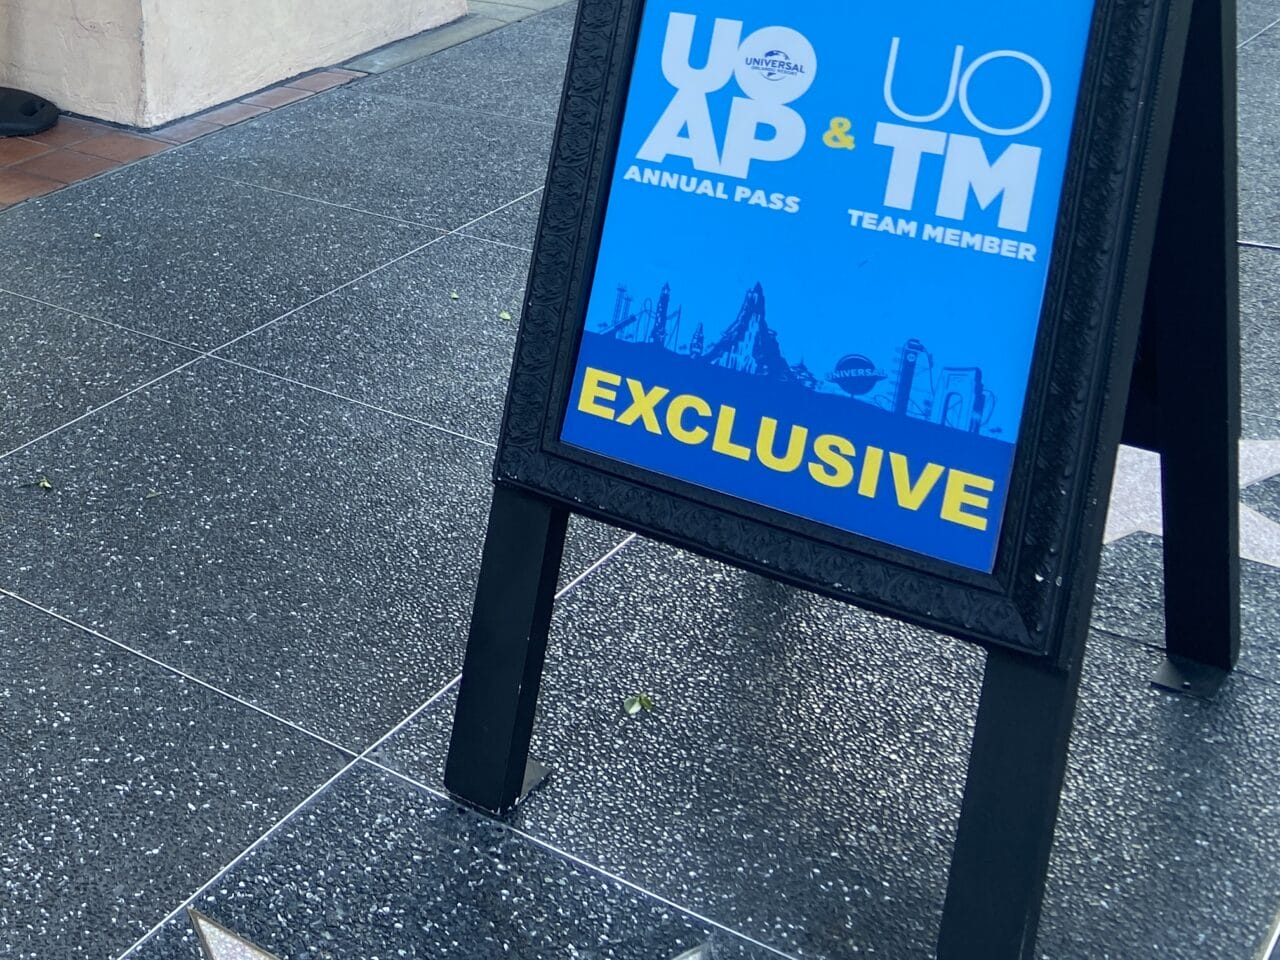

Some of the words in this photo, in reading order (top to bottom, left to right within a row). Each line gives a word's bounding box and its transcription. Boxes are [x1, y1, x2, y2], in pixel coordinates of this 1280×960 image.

[745, 56, 806, 74] UNIVERSAL
[883, 36, 1053, 137] UO
[822, 116, 856, 151] &
[623, 165, 729, 201] ANNUAL
[734, 185, 801, 214] PASS
[873, 121, 1042, 233] TM
[847, 208, 918, 239] TEAM
[922, 222, 1038, 262] MEMBER
[824, 367, 887, 380] UNIVERSAL
[577, 366, 995, 531] EXCLUSIVE
